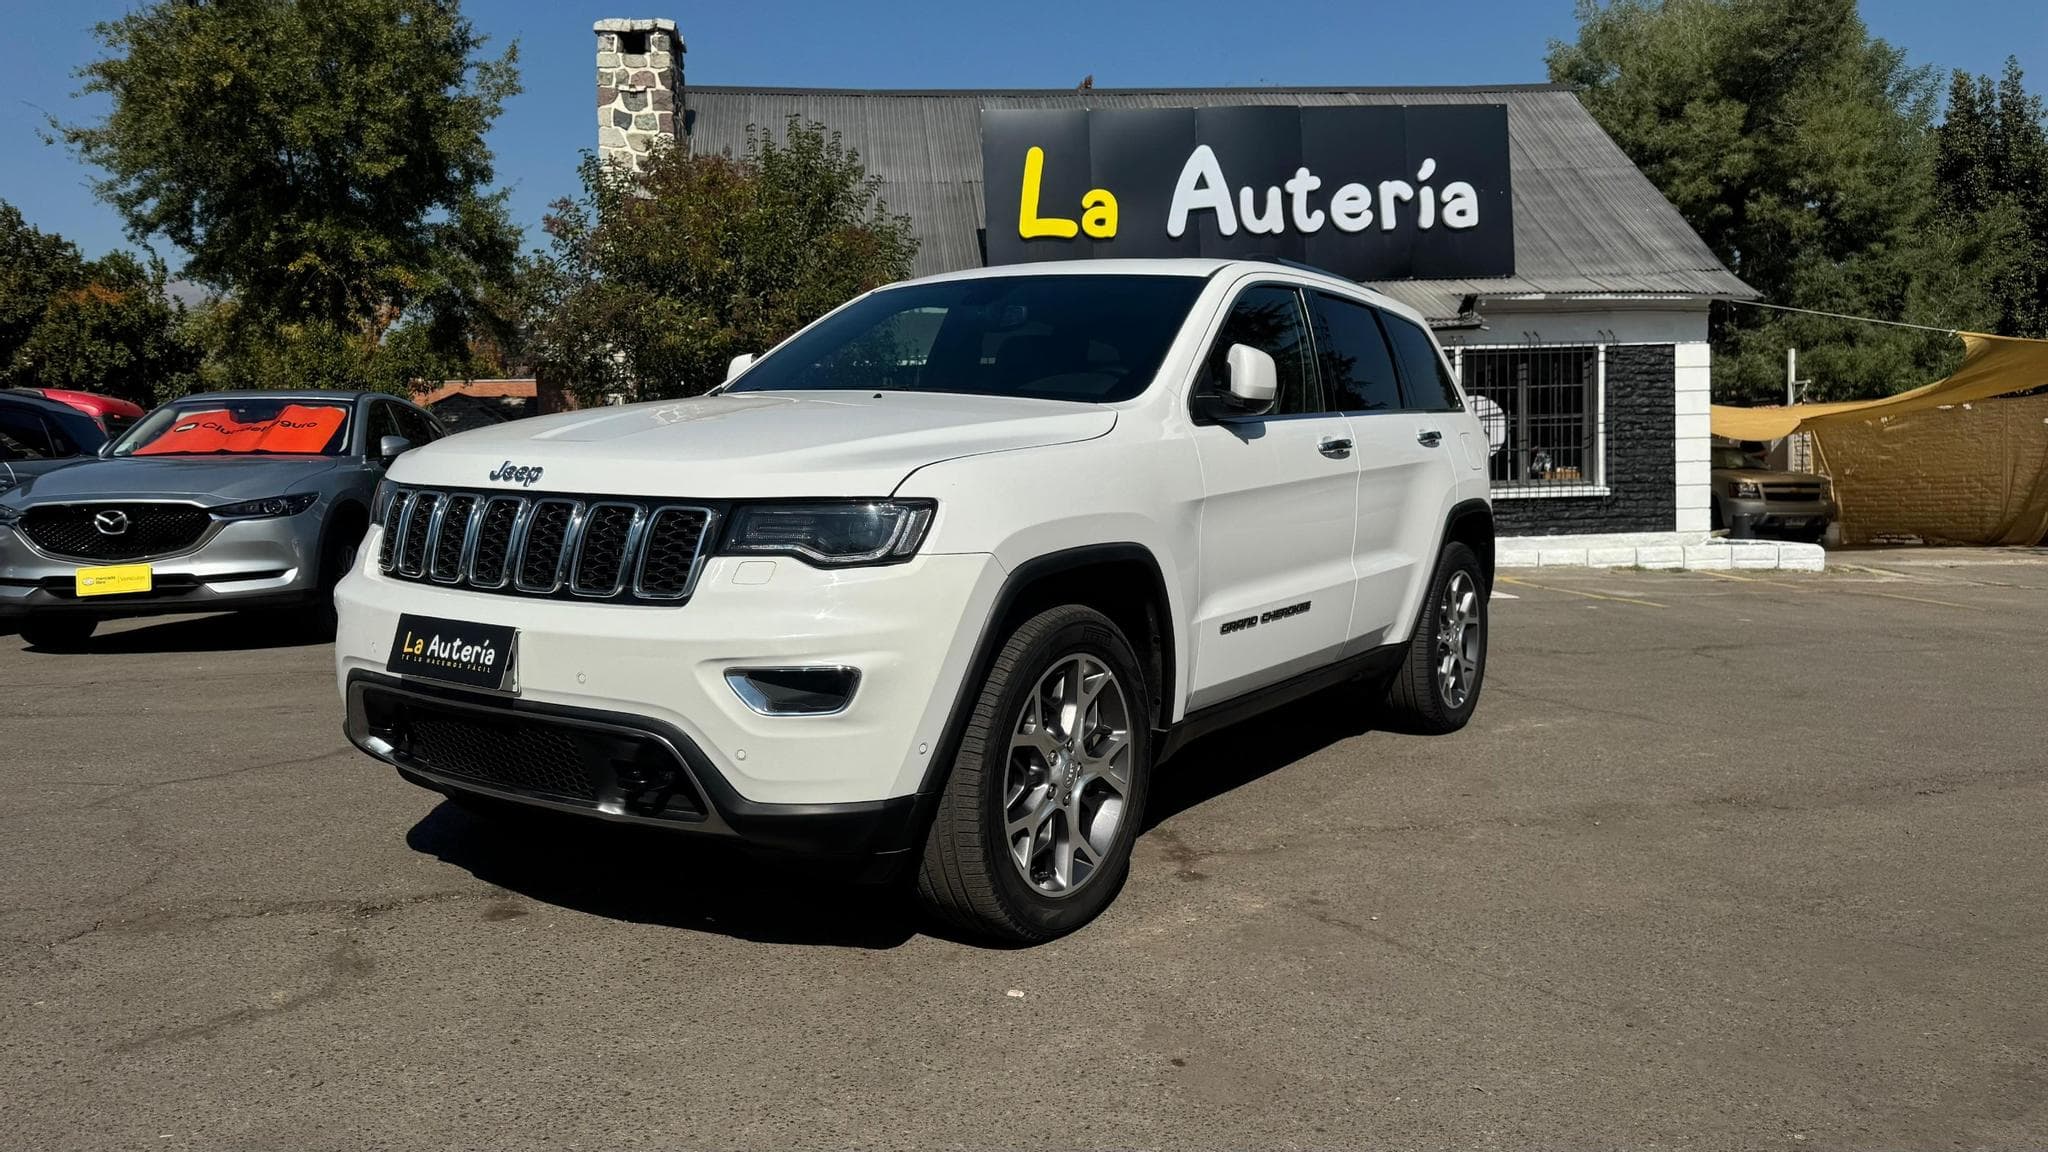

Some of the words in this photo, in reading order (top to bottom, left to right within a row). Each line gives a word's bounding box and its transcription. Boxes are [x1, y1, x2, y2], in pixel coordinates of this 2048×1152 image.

[1018, 146, 1119, 239] La
[1166, 144, 1480, 238] Autería
[489, 460, 544, 487] Jeep
[1220, 615, 1259, 635] GRAND
[1260, 600, 1312, 624] CHEROKEE
[403, 631, 424, 654] La
[427, 634, 495, 665] Autería
